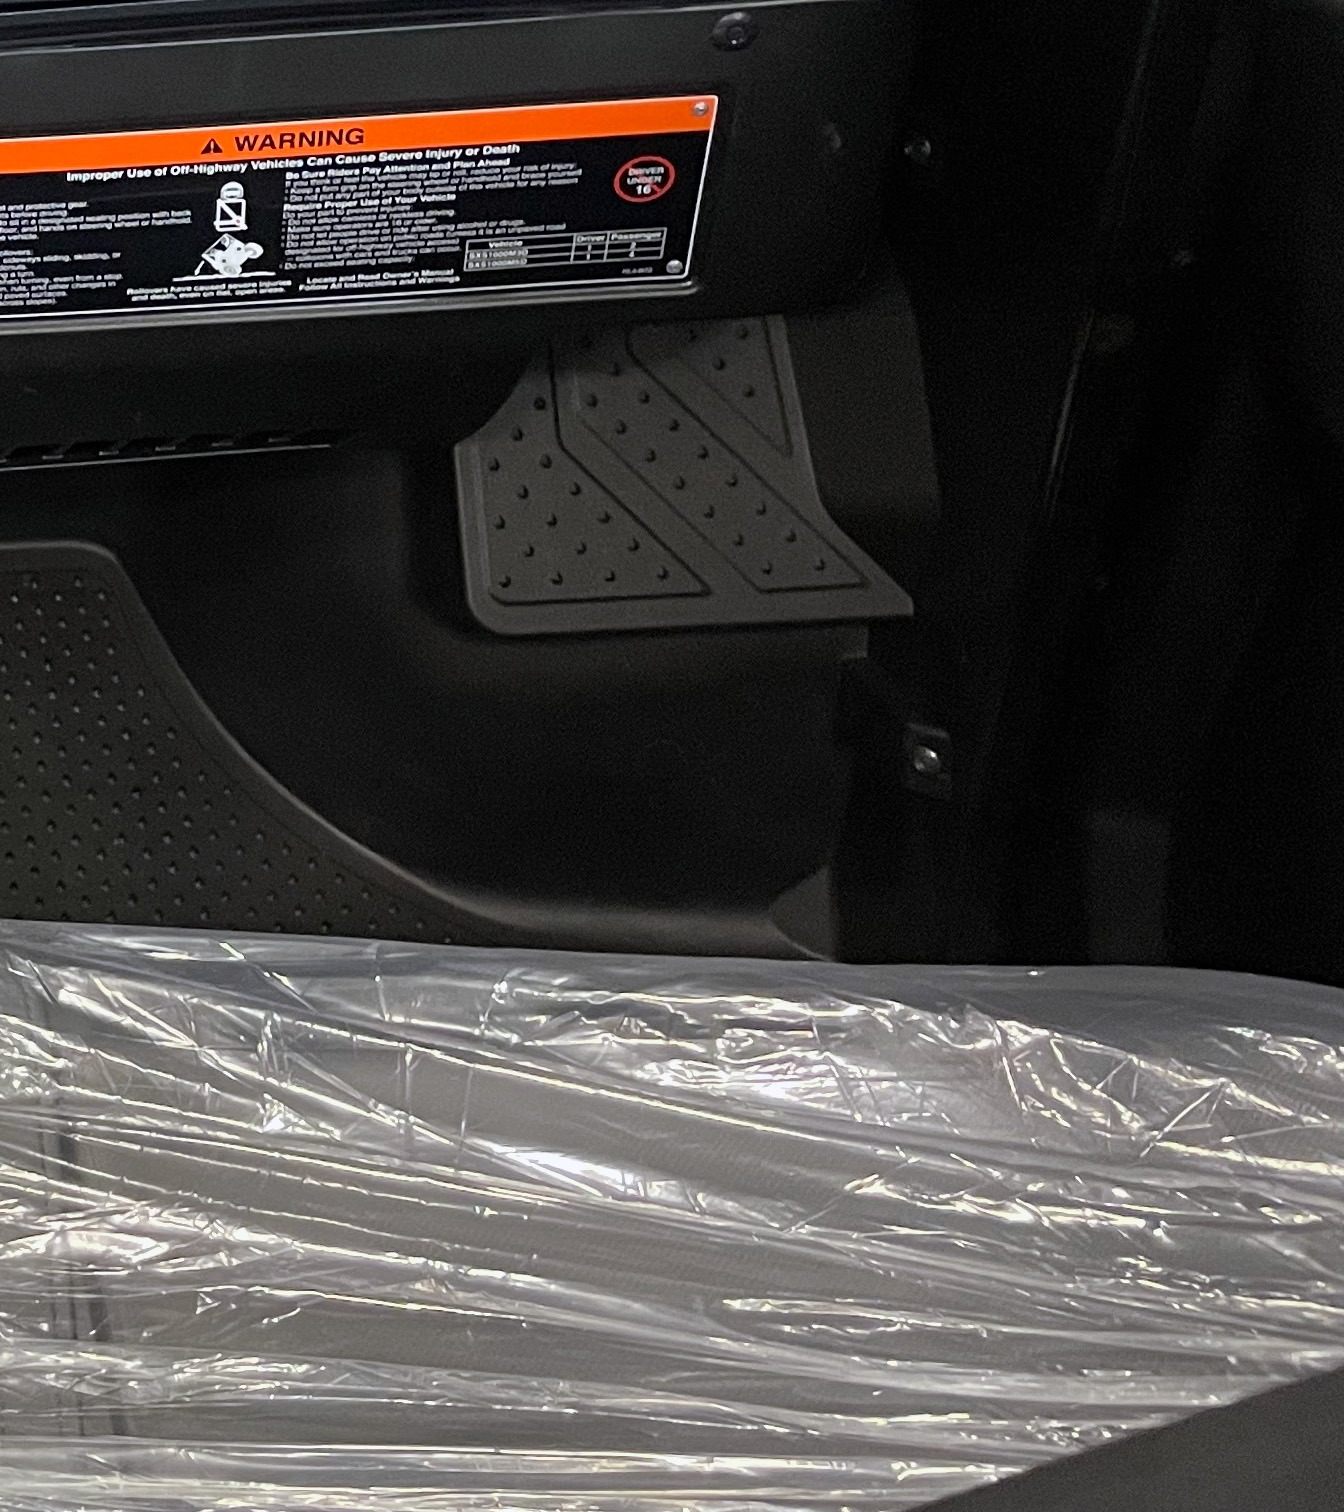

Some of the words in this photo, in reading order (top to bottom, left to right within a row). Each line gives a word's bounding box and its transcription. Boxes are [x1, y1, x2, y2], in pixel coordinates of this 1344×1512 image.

[235, 127, 365, 154] WARNING
[67, 168, 125, 183] Improper
[126, 167, 152, 179] Use
[153, 166, 168, 177] of
[169, 161, 249, 176] Off-Highway
[250, 157, 305, 171] Vehicles
[306, 156, 332, 168] Can
[333, 153, 376, 166] Cause
[377, 150, 423, 164] Severe
[424, 147, 463, 161] Injury
[464, 146, 481, 158] or
[482, 144, 520, 157] Death
[635, 185, 651, 195] 16
